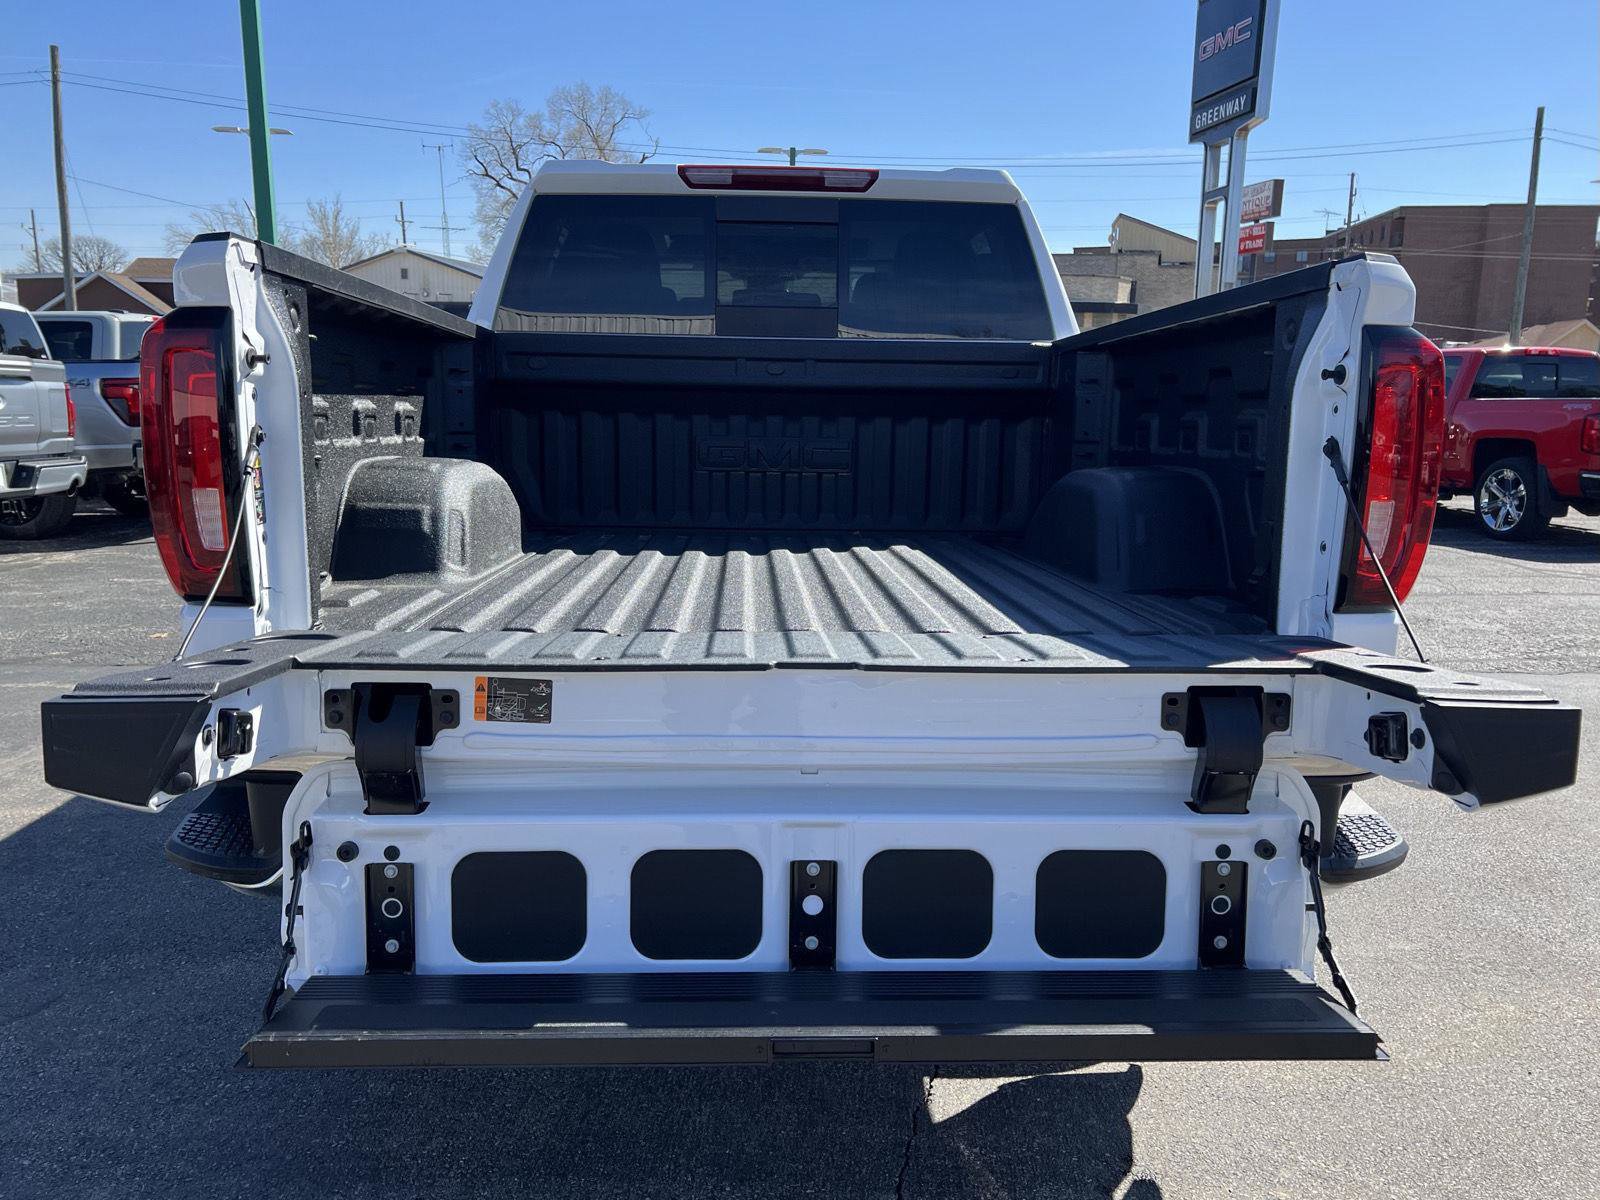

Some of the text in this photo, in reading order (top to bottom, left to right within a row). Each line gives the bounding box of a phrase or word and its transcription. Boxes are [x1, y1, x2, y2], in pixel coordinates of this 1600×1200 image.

[1199, 17, 1253, 61] GMC
[1195, 94, 1247, 129] GREENWAY
[1241, 195, 1271, 212] NTIQUE
[1245, 239, 1264, 250] TRADE
[696, 438, 851, 472] GMC
